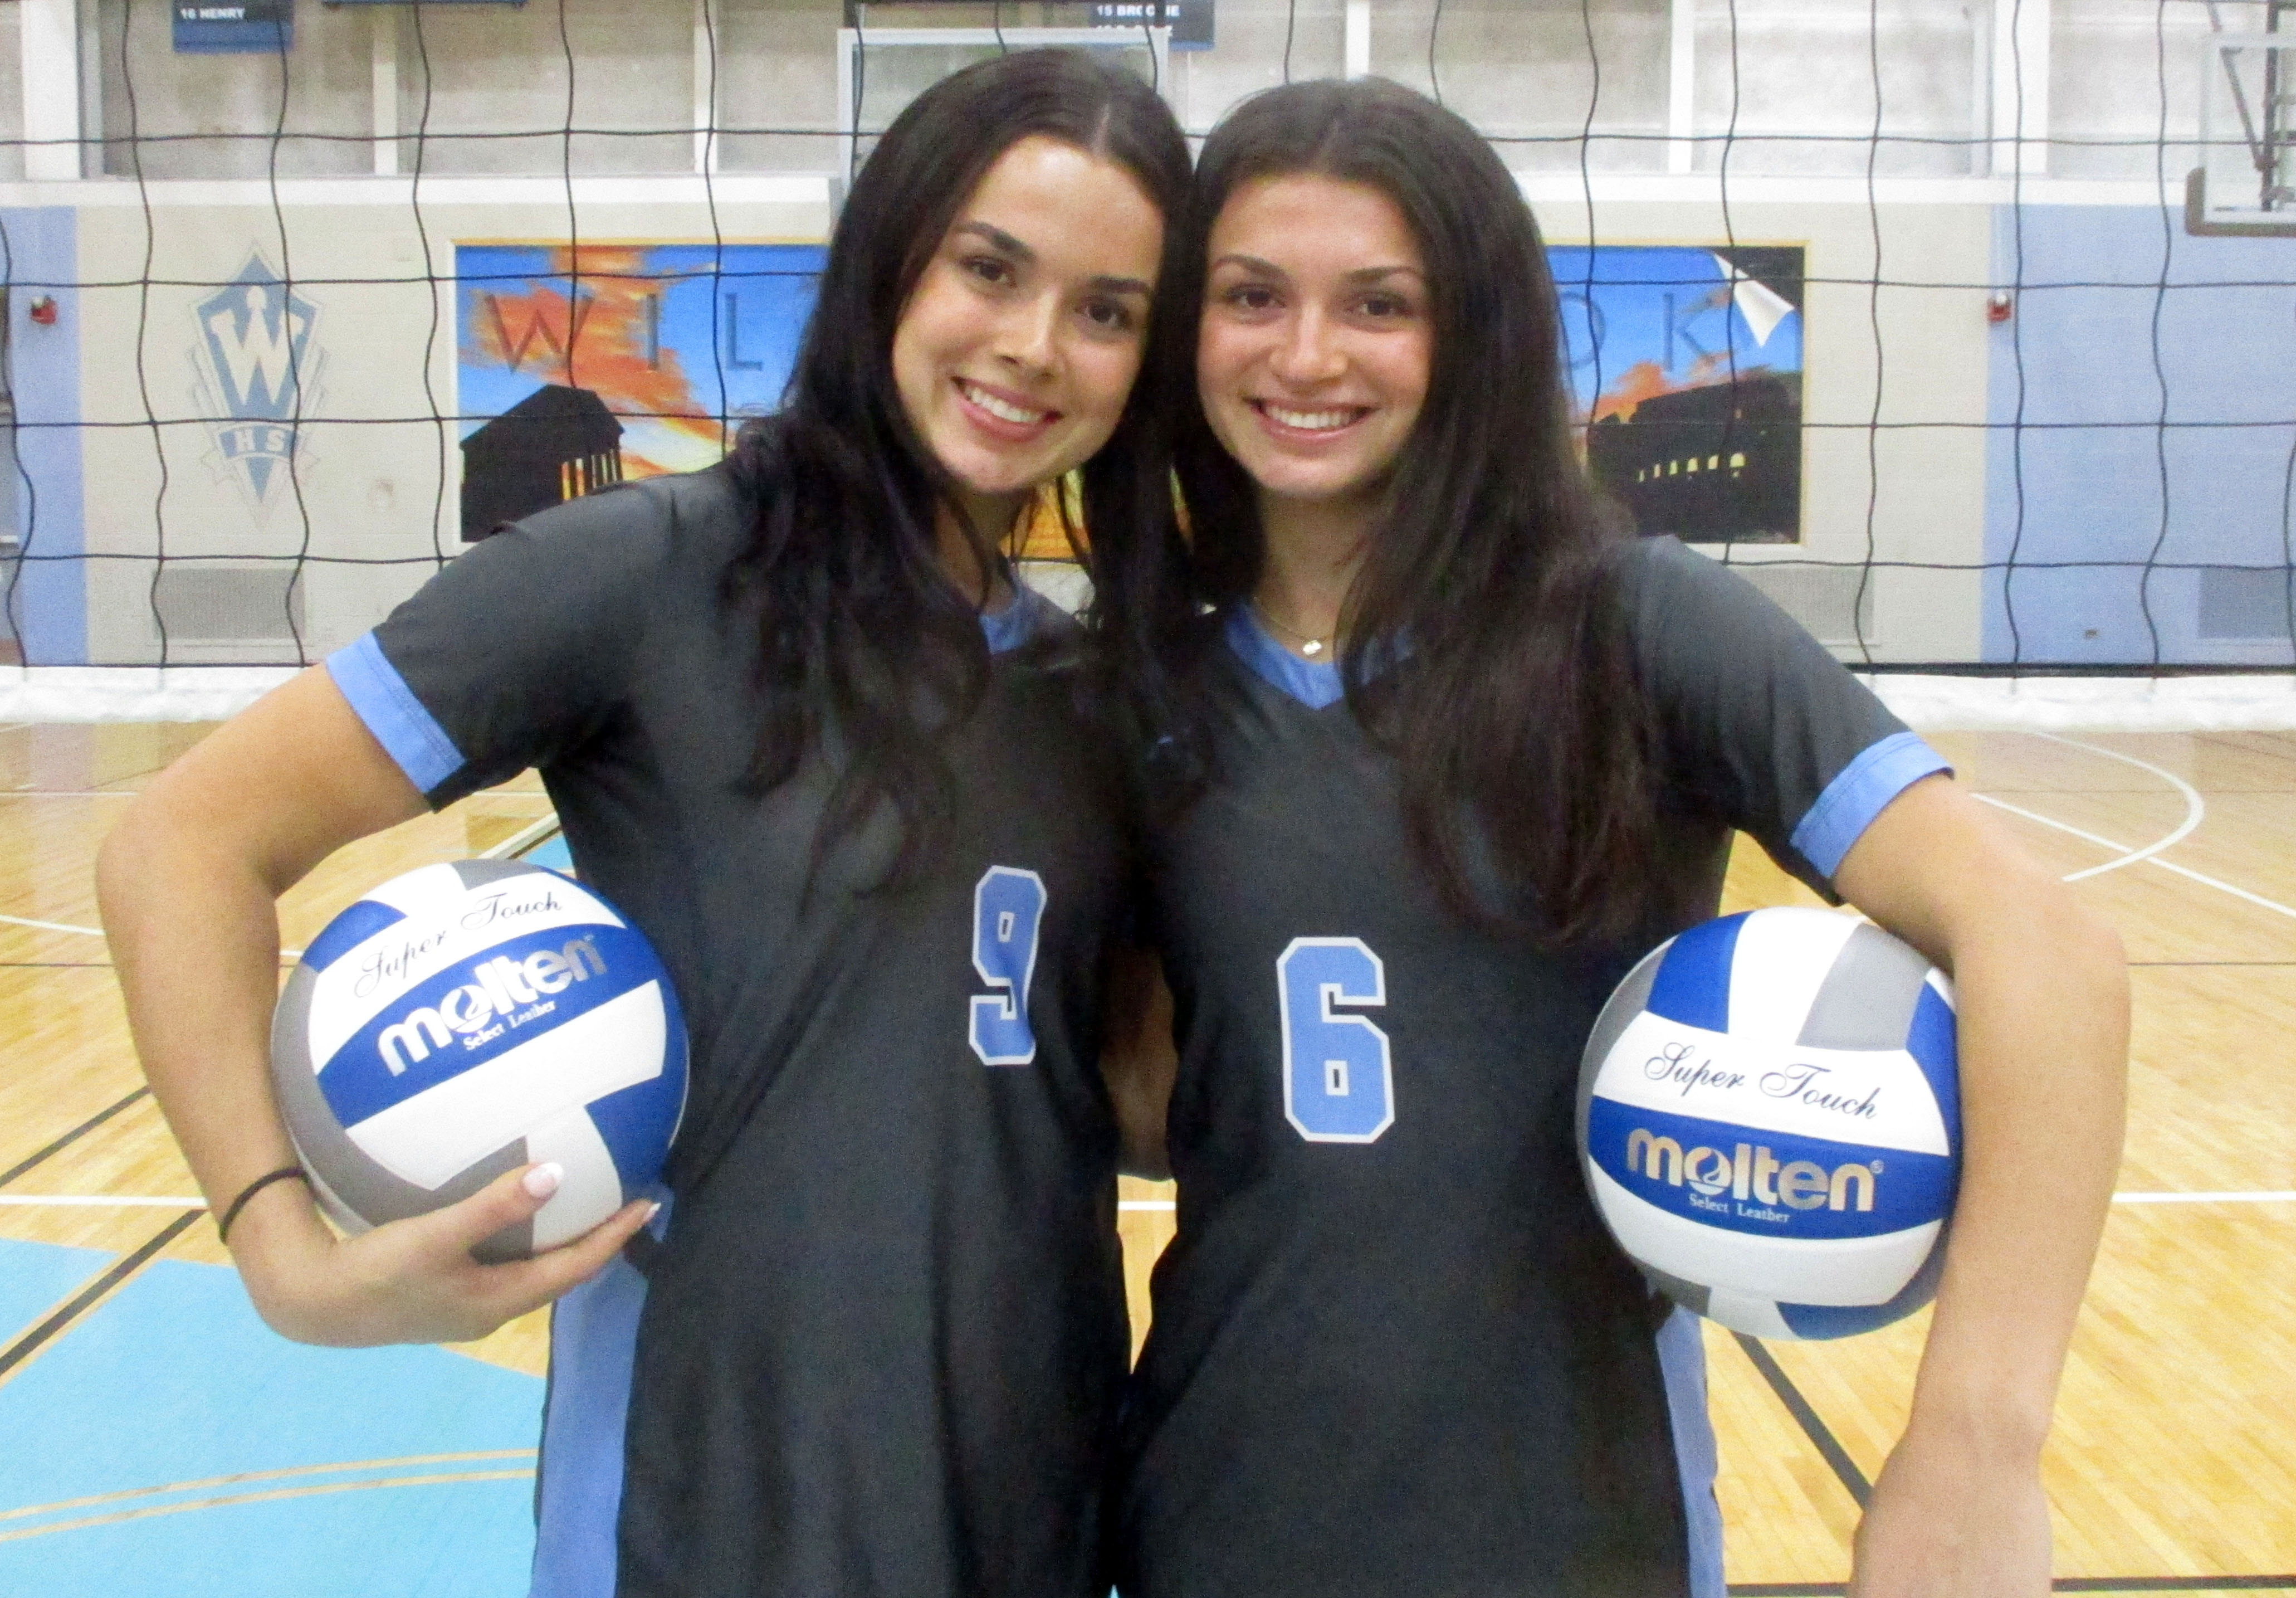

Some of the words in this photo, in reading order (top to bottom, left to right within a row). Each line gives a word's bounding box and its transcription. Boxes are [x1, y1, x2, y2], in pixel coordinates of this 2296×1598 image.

[210, 285, 305, 406] W
[482, 291, 763, 373] WIL
[354, 930, 446, 998] Super
[460, 892, 563, 930] Touch
[969, 865, 1048, 1065] 9
[378, 938, 607, 1077] molten
[463, 1022, 506, 1051] Select
[507, 1001, 556, 1029] Leather
[1276, 937, 1395, 1143] 6
[1644, 1042, 1745, 1097] Super
[1760, 1063, 1882, 1119] Touch
[1627, 1128, 1875, 1212] molten
[1688, 1193, 1729, 1214] Select
[1736, 1202, 1791, 1224] Leather
